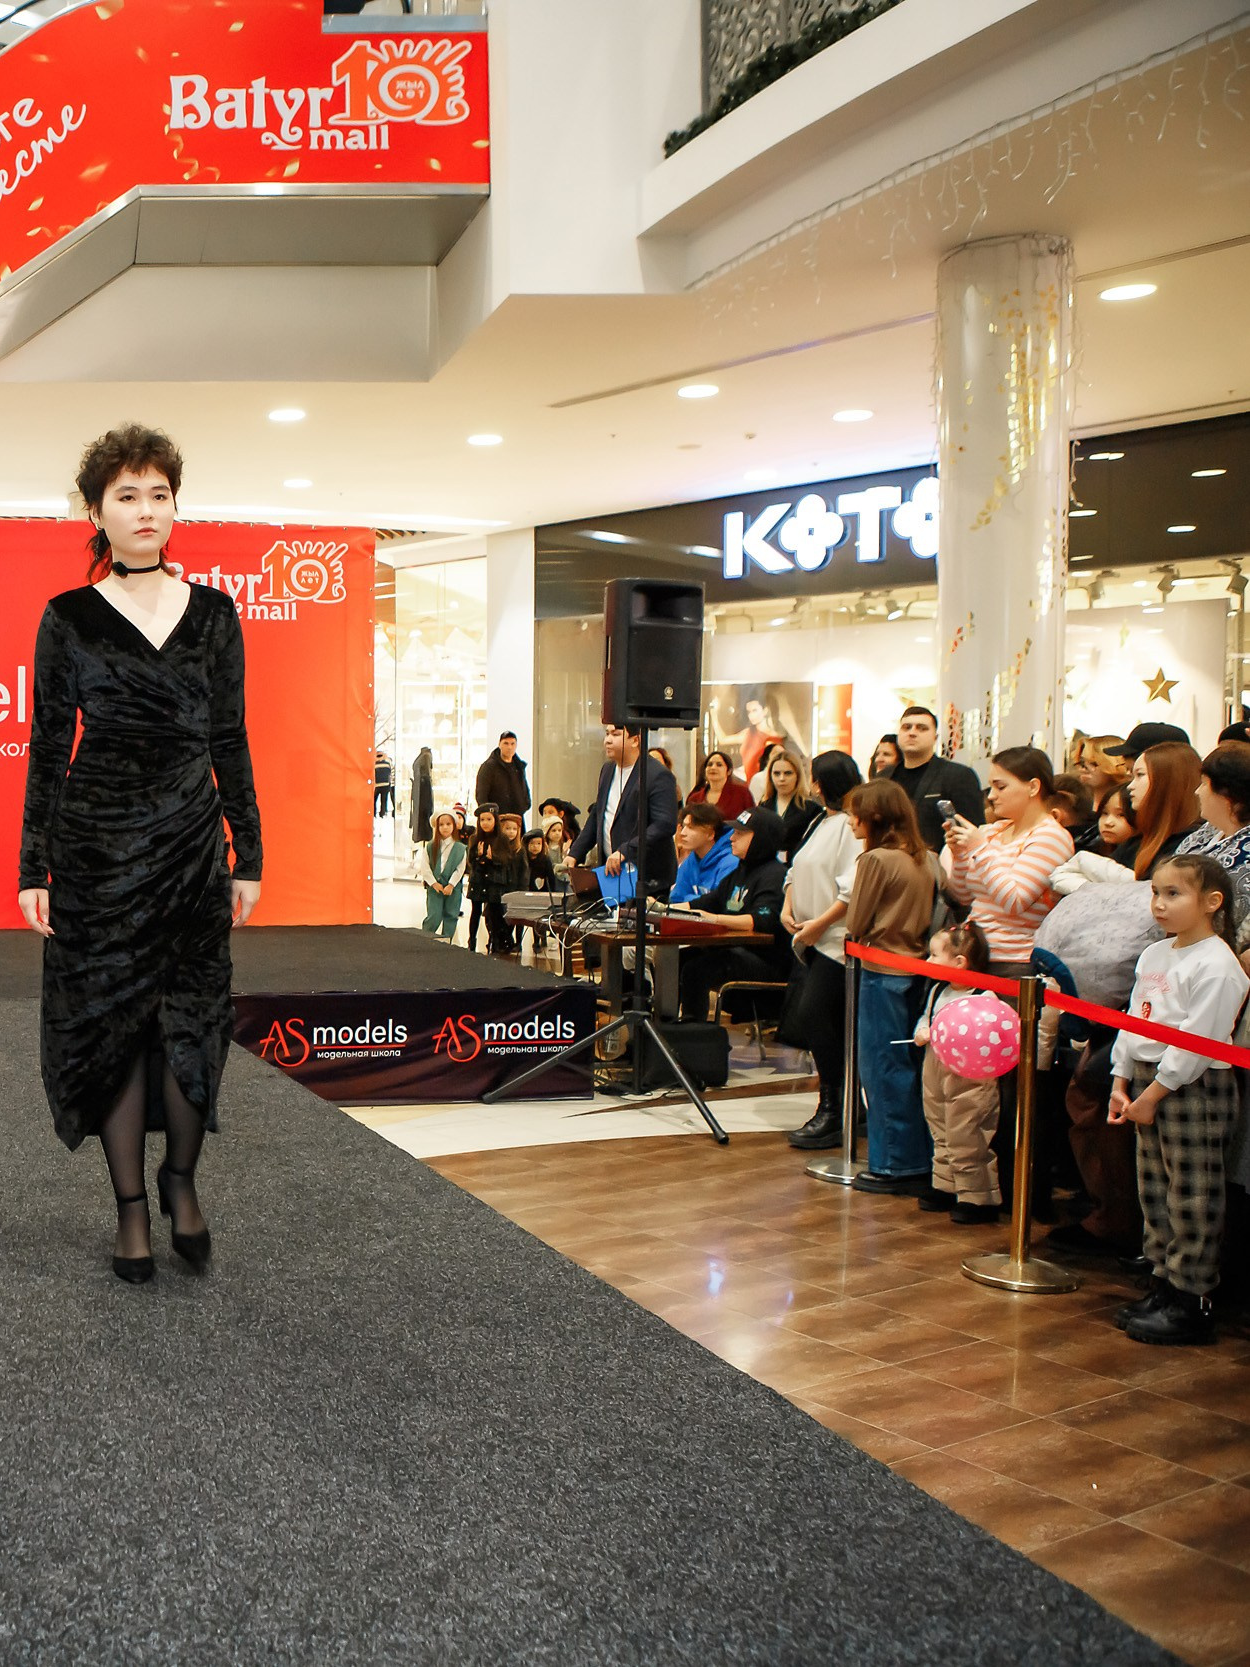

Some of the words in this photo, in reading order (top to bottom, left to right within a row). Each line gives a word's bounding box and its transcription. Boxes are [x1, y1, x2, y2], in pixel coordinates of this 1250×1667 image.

[170, 74, 334, 150] Batyr
[309, 124, 390, 150] mall
[247, 602, 297, 621] mall
[259, 1018, 310, 1067] AS
[313, 1019, 408, 1045] models
[432, 1014, 481, 1063] AS
[484, 1015, 575, 1041] models
[487, 1046, 538, 1055] модельная
[317, 1050, 369, 1060] модельная
[370, 1049, 401, 1058] школа
